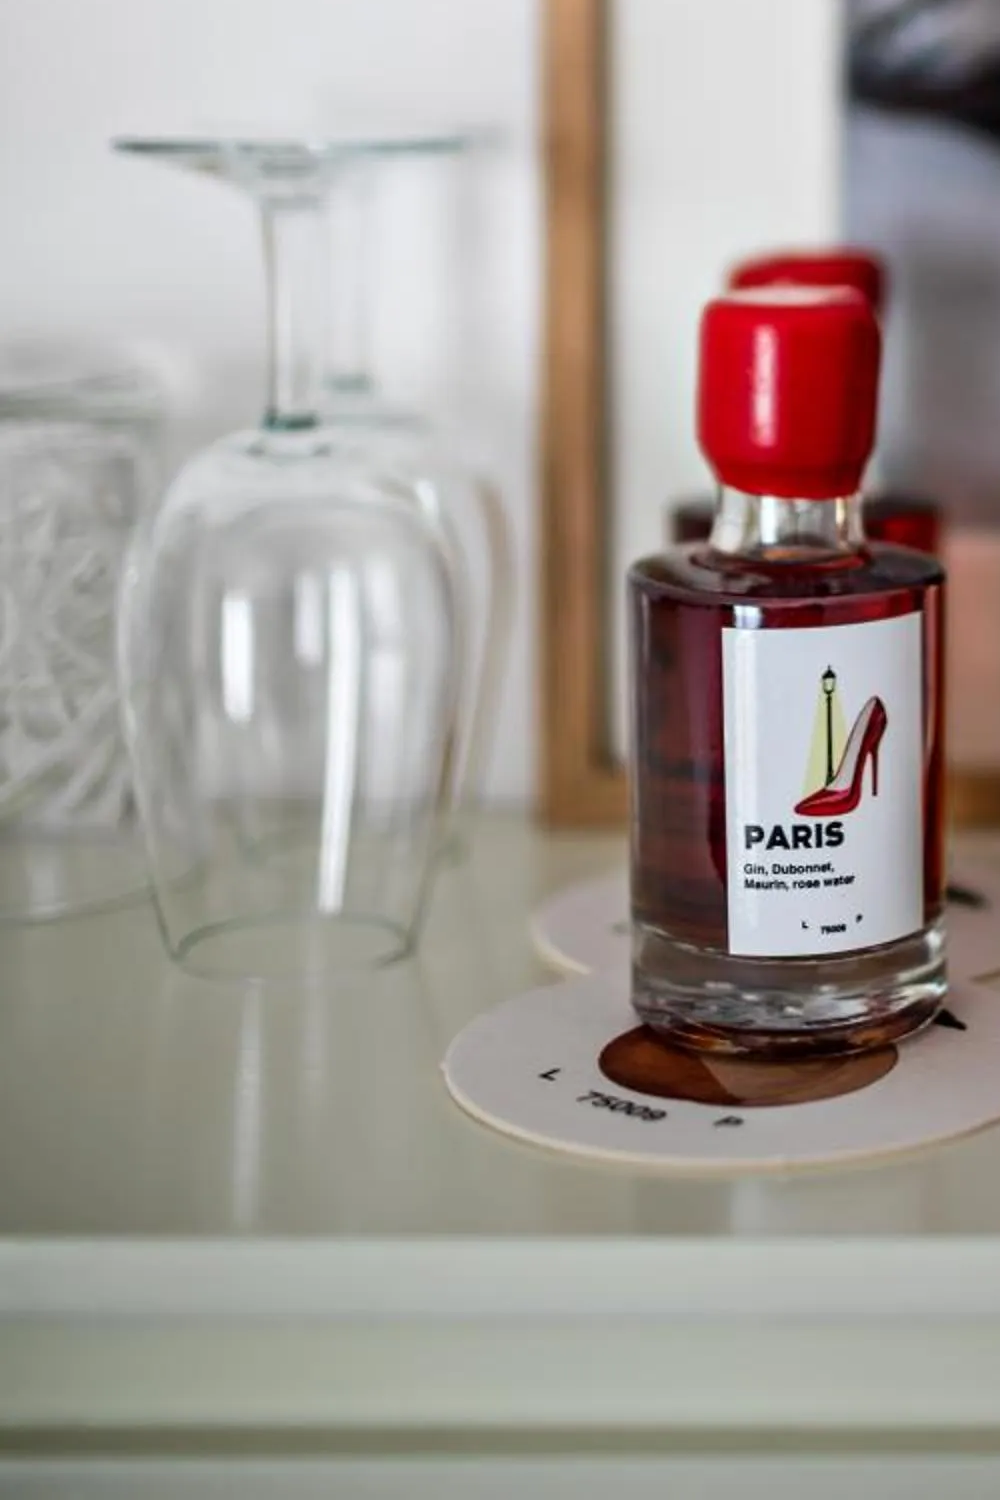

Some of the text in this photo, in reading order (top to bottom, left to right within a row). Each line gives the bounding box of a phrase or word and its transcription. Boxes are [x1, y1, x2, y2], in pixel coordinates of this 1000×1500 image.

[743, 820, 845, 851] PARIS
[742, 862, 770, 877] Gin,
[791, 879, 821, 890] rose
[823, 874, 856, 888] water
